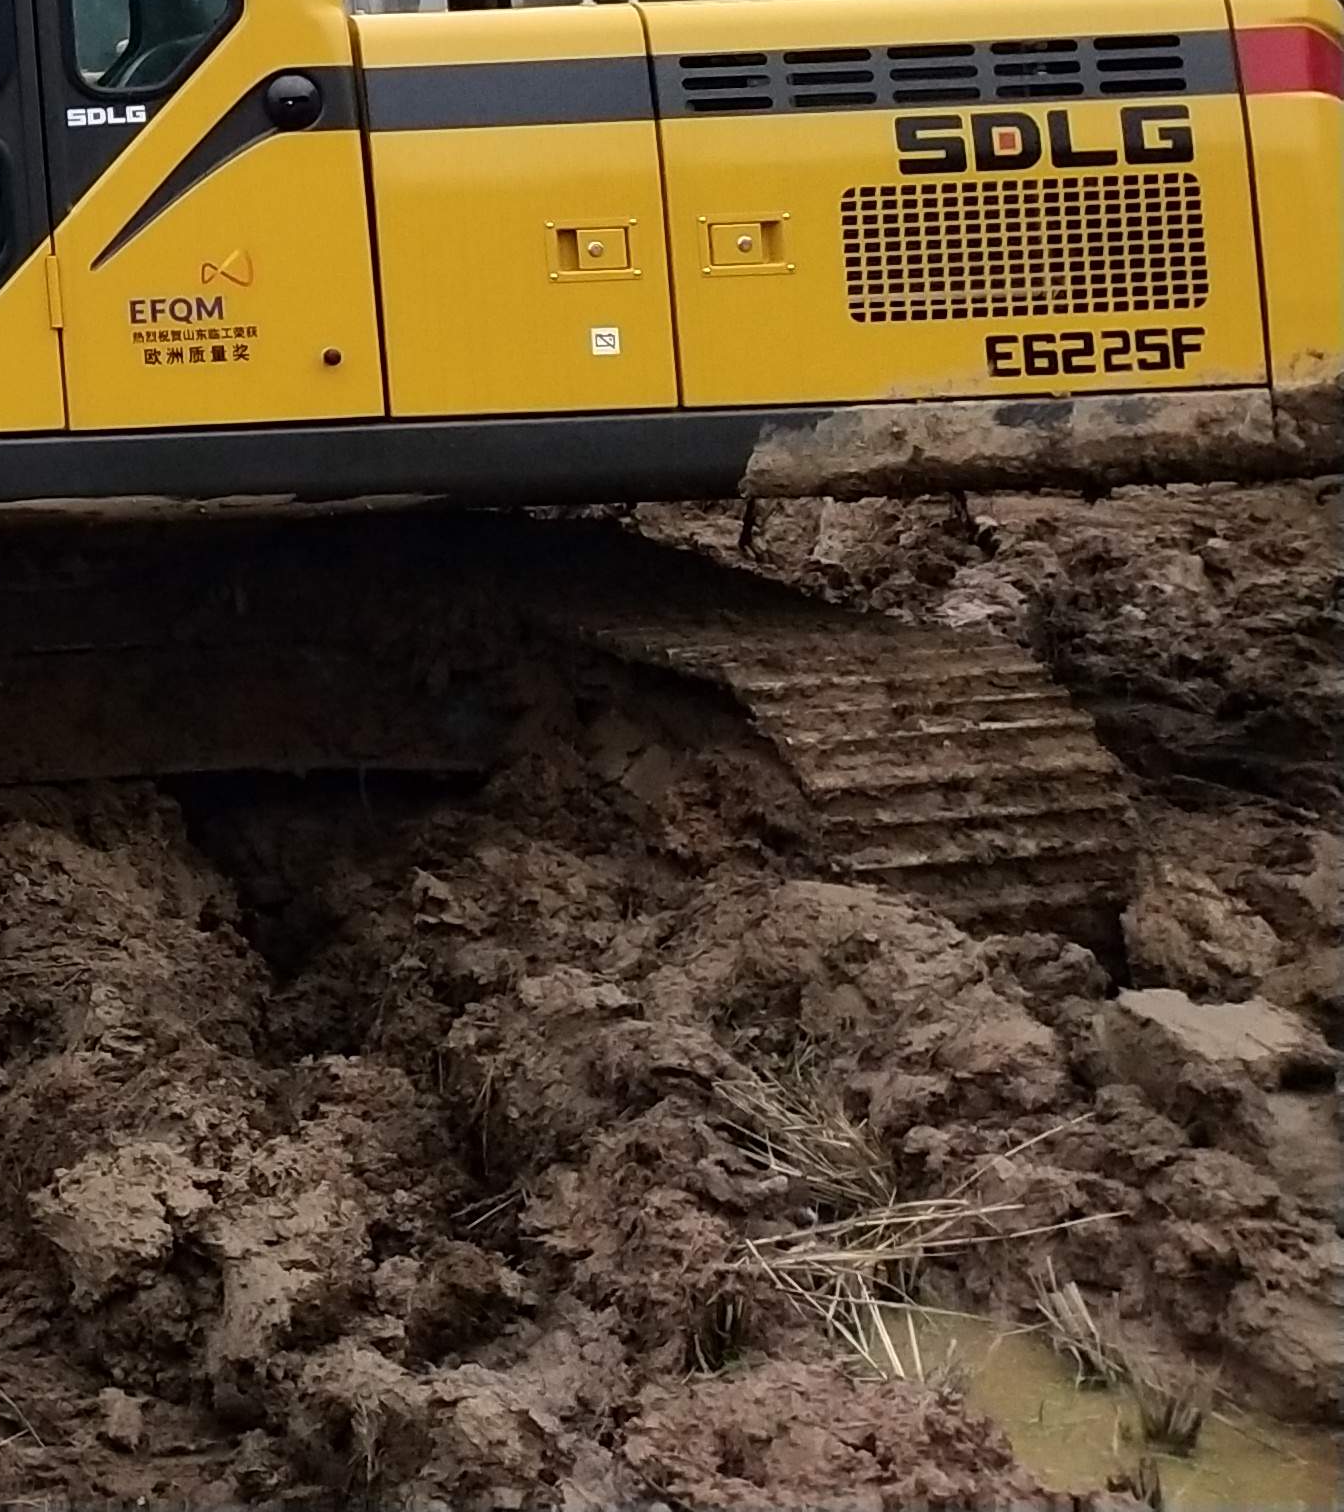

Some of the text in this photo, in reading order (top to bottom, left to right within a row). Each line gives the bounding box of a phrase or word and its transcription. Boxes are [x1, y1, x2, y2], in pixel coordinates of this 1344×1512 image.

[67, 105, 146, 126] SDLG
[895, 105, 1194, 175] SDLG
[129, 296, 224, 324] EFQM
[144, 344, 250, 364] 欧洲质量奖
[985, 327, 1205, 377] E6225F
